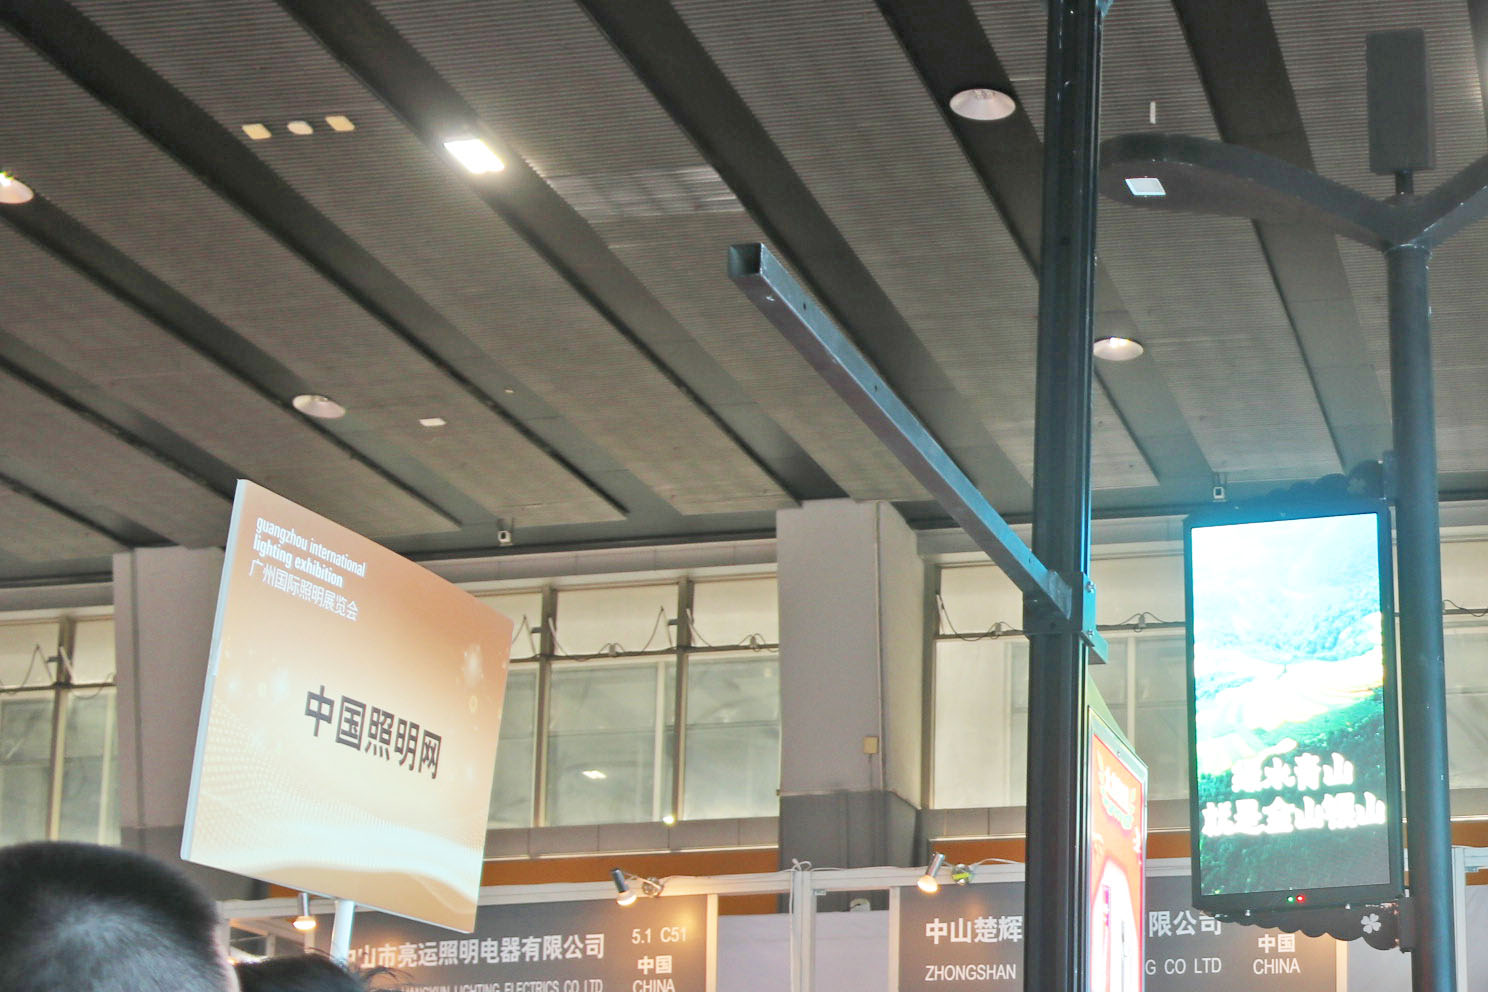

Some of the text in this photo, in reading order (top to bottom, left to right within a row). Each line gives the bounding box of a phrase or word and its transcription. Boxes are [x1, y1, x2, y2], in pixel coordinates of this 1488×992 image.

[256, 517, 367, 577] guangzhou international
[253, 533, 344, 588] lighting exhibition
[249, 558, 359, 622] 广州国际照明展览会
[304, 685, 442, 779] 中国照明网
[631, 927, 687, 944] 5.1 C51
[1257, 934, 1296, 954] 中国
[637, 955, 673, 975] 中国
[924, 963, 1016, 982] ZHONGSHAN
[1164, 958, 1187, 975] CO
[1194, 957, 1222, 974] LTD
[1252, 957, 1301, 975] CHINA
